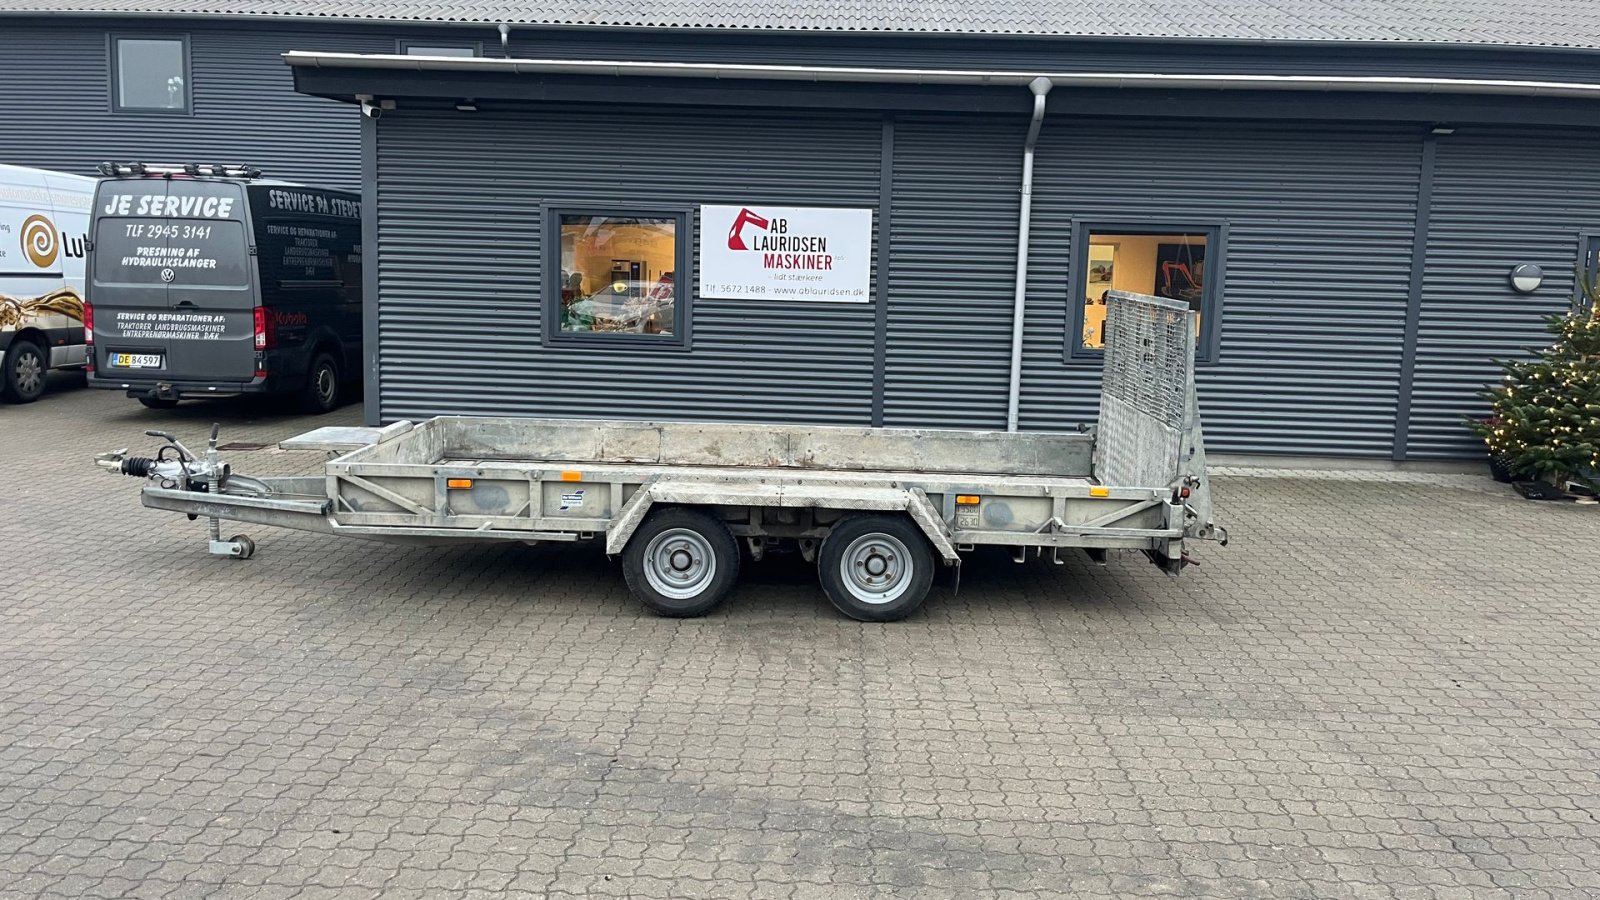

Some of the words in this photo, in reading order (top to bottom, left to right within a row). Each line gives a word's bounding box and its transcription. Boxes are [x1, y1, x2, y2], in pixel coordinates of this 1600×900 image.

[105, 195, 133, 215] JE
[137, 196, 234, 218] SERVICE
[270, 190, 314, 212] SERVICE
[332, 198, 362, 218] STEDET
[126, 224, 144, 238] TLF
[148, 225, 179, 239] 2945
[183, 226, 211, 239] 3141
[267, 225, 288, 235] SERVICE
[770, 218, 788, 234] AB
[754, 236, 826, 252] LAURIDSEN
[136, 247, 184, 257] PRESNING
[187, 248, 200, 257] AF
[122, 256, 216, 268] HYDRAULIKSLANGER
[764, 254, 832, 270] MASKINER
[720, 284, 742, 294] 5672
[745, 285, 766, 294] 1488
[774, 287, 864, 296] www.ablauridsen.dk
[158, 314, 212, 322] REPARATIONER
[155, 323, 225, 332] LANDBRUGSMASKINER
